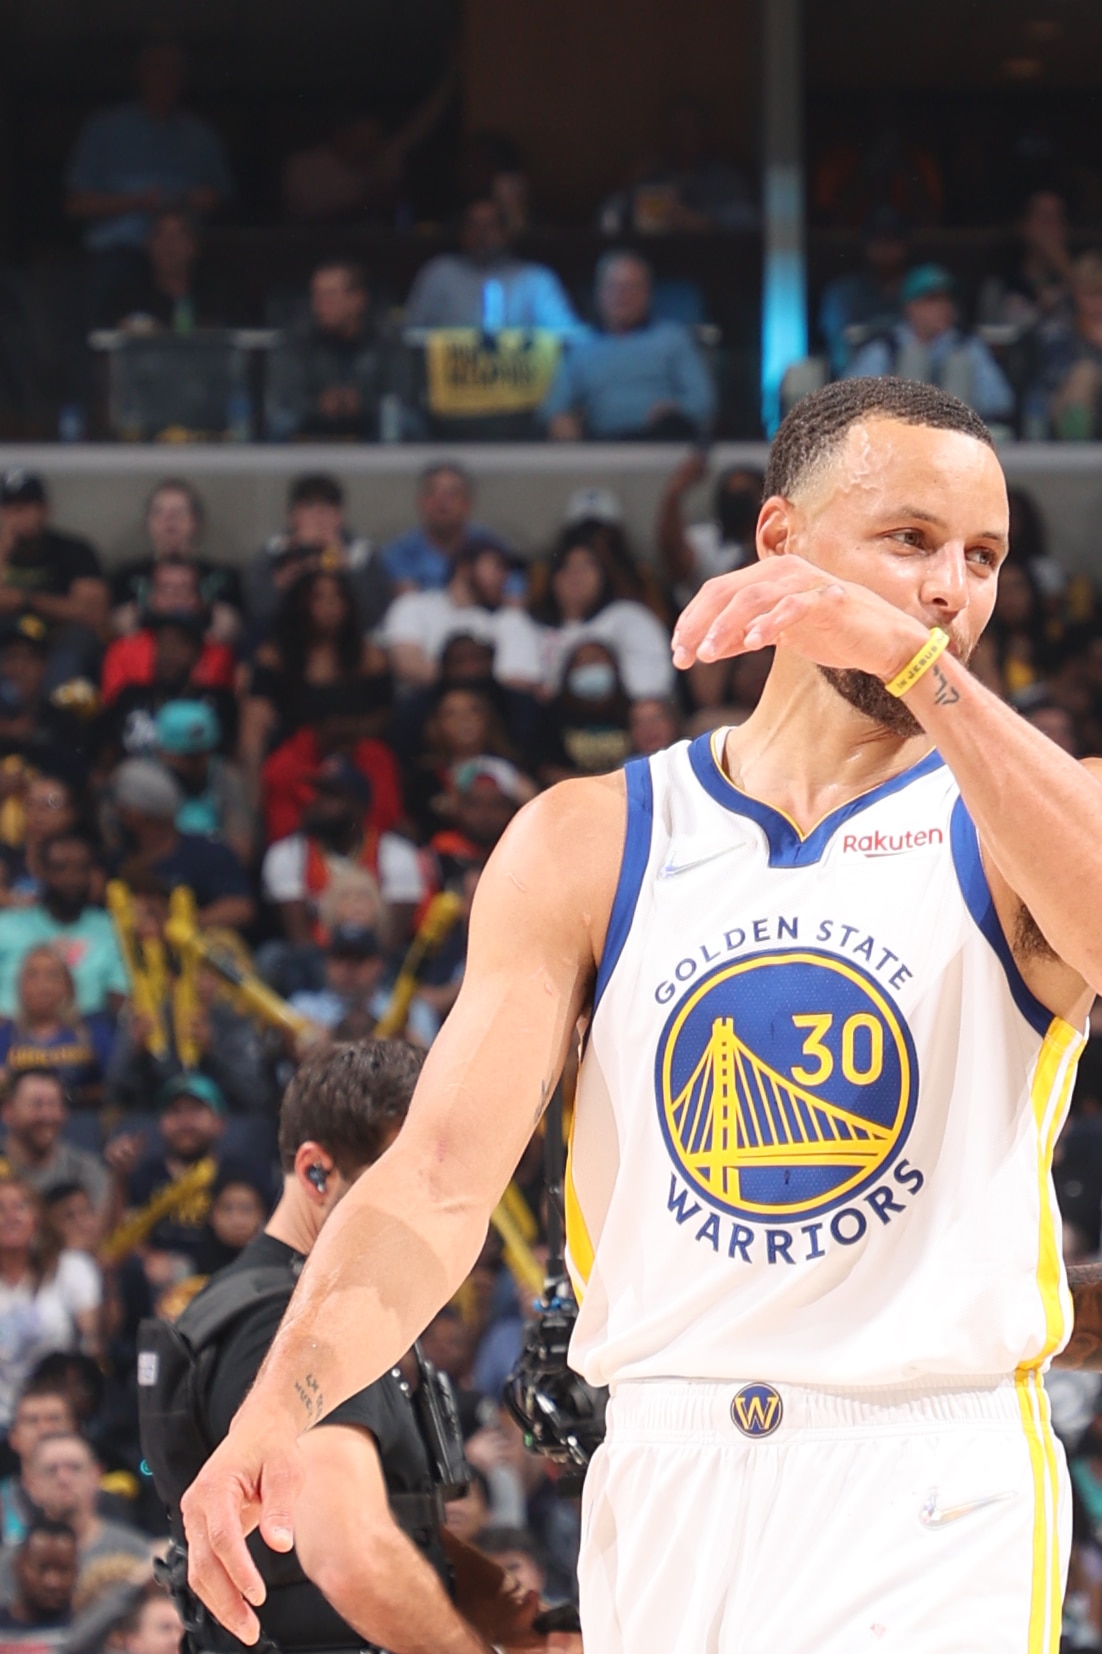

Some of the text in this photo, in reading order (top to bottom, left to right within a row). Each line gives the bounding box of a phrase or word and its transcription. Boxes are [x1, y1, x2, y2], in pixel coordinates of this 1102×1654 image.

[843, 827, 943, 854] Rakuten
[654, 916, 914, 1004] GOLDEN STATE
[791, 1013, 884, 1086] 30
[666, 1158, 925, 1264] WARRIORS
[735, 1395, 779, 1430] W
